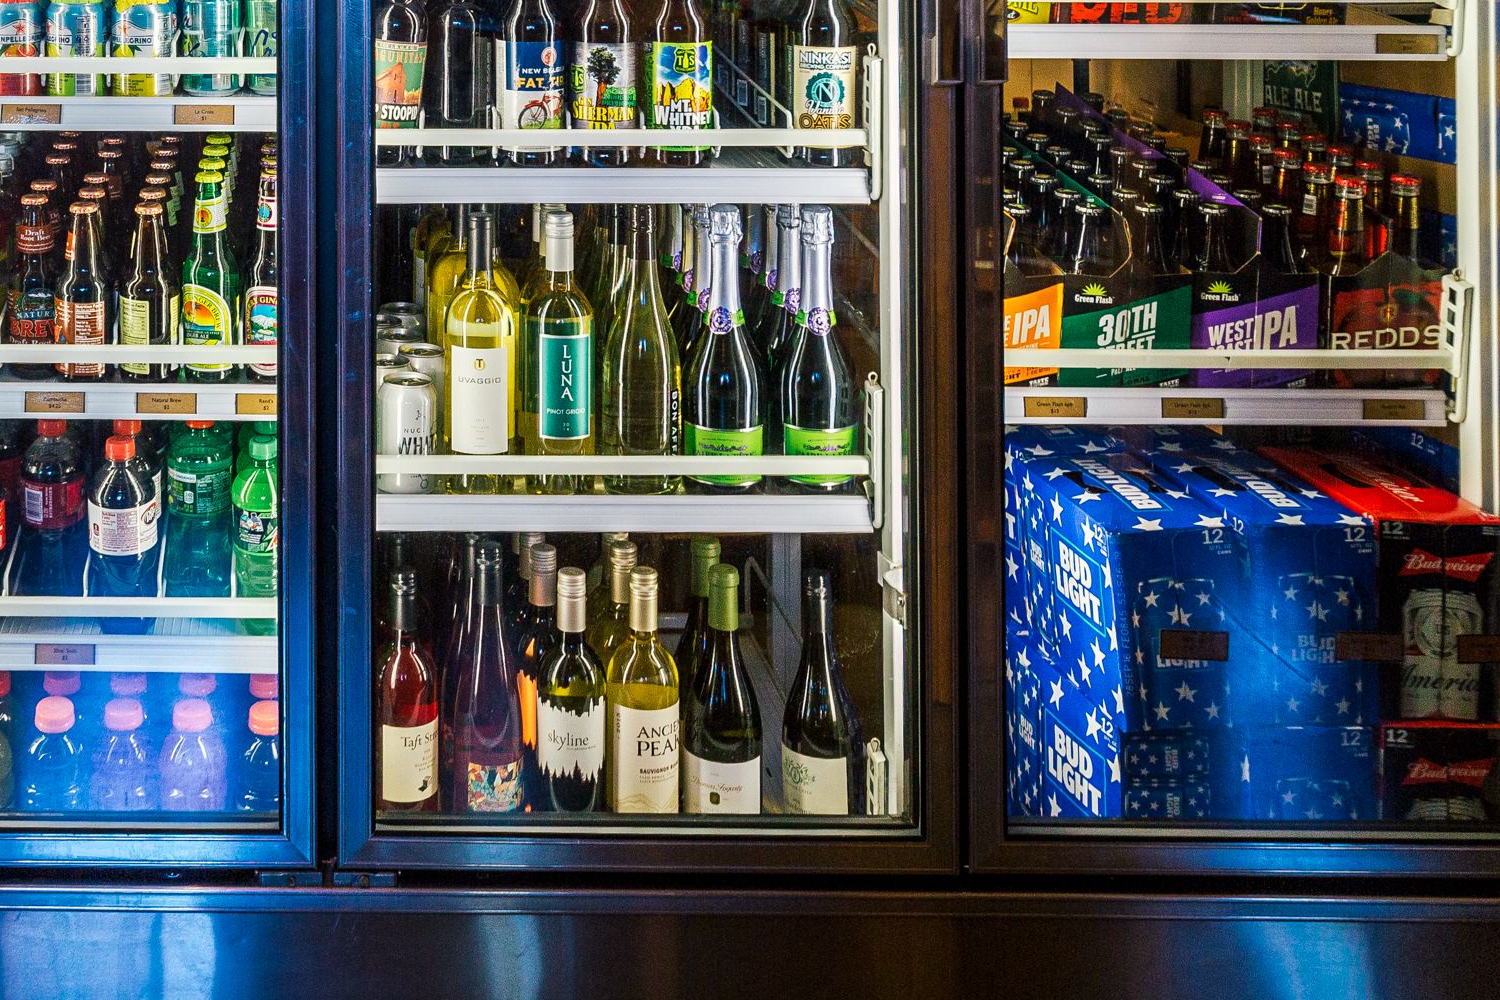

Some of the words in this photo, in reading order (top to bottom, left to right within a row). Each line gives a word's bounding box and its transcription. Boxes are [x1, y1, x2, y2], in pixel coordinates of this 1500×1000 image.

[800, 50, 851, 64] NINKASI
[518, 78, 544, 89] FAT
[670, 99, 693, 113] MT.
[1298, 88, 1323, 113] ALE
[381, 104, 418, 121] STOOPID
[573, 100, 634, 120] SHERMAN
[655, 105, 711, 126] WHITNEY
[799, 113, 851, 129] OATIS
[24, 228, 46, 237] Draft
[1075, 294, 1095, 303] Green
[1096, 295, 1113, 304] Flash
[1201, 292, 1219, 301] Green
[1220, 293, 1239, 302] Flash
[1012, 304, 1051, 346] IPA
[1096, 301, 1159, 347] 30TH
[1208, 319, 1252, 345] WEST
[1254, 305, 1299, 350] IPA
[458, 376, 501, 385] UVAGGIO
[560, 344, 574, 402] LUNA
[565, 407, 585, 415] GRIGIO
[1411, 433, 1424, 447] 12
[1254, 479, 1301, 509] BUD
[1092, 523, 1104, 540] 12
[1232, 516, 1244, 535] 12
[1383, 521, 1404, 535] 12
[1202, 528, 1224, 545] 12
[1343, 527, 1366, 542] 12
[1030, 550, 1045, 573] LIGHT
[1059, 540, 1093, 590] BUD
[1403, 551, 1486, 573] Budweiser
[1055, 576, 1102, 626] LIGHT
[1100, 717, 1114, 736] 12
[400, 735, 423, 749] Taft
[548, 732, 589, 751] skyline
[1018, 725, 1036, 750] LIGHT
[1341, 731, 1361, 746] 12
[1386, 729, 1409, 743] 12
[1053, 723, 1093, 781] BUD
[639, 767, 668, 775] SAUVIGNON
[1408, 762, 1491, 779] Budweiser
[1047, 745, 1102, 819] LIGHT
